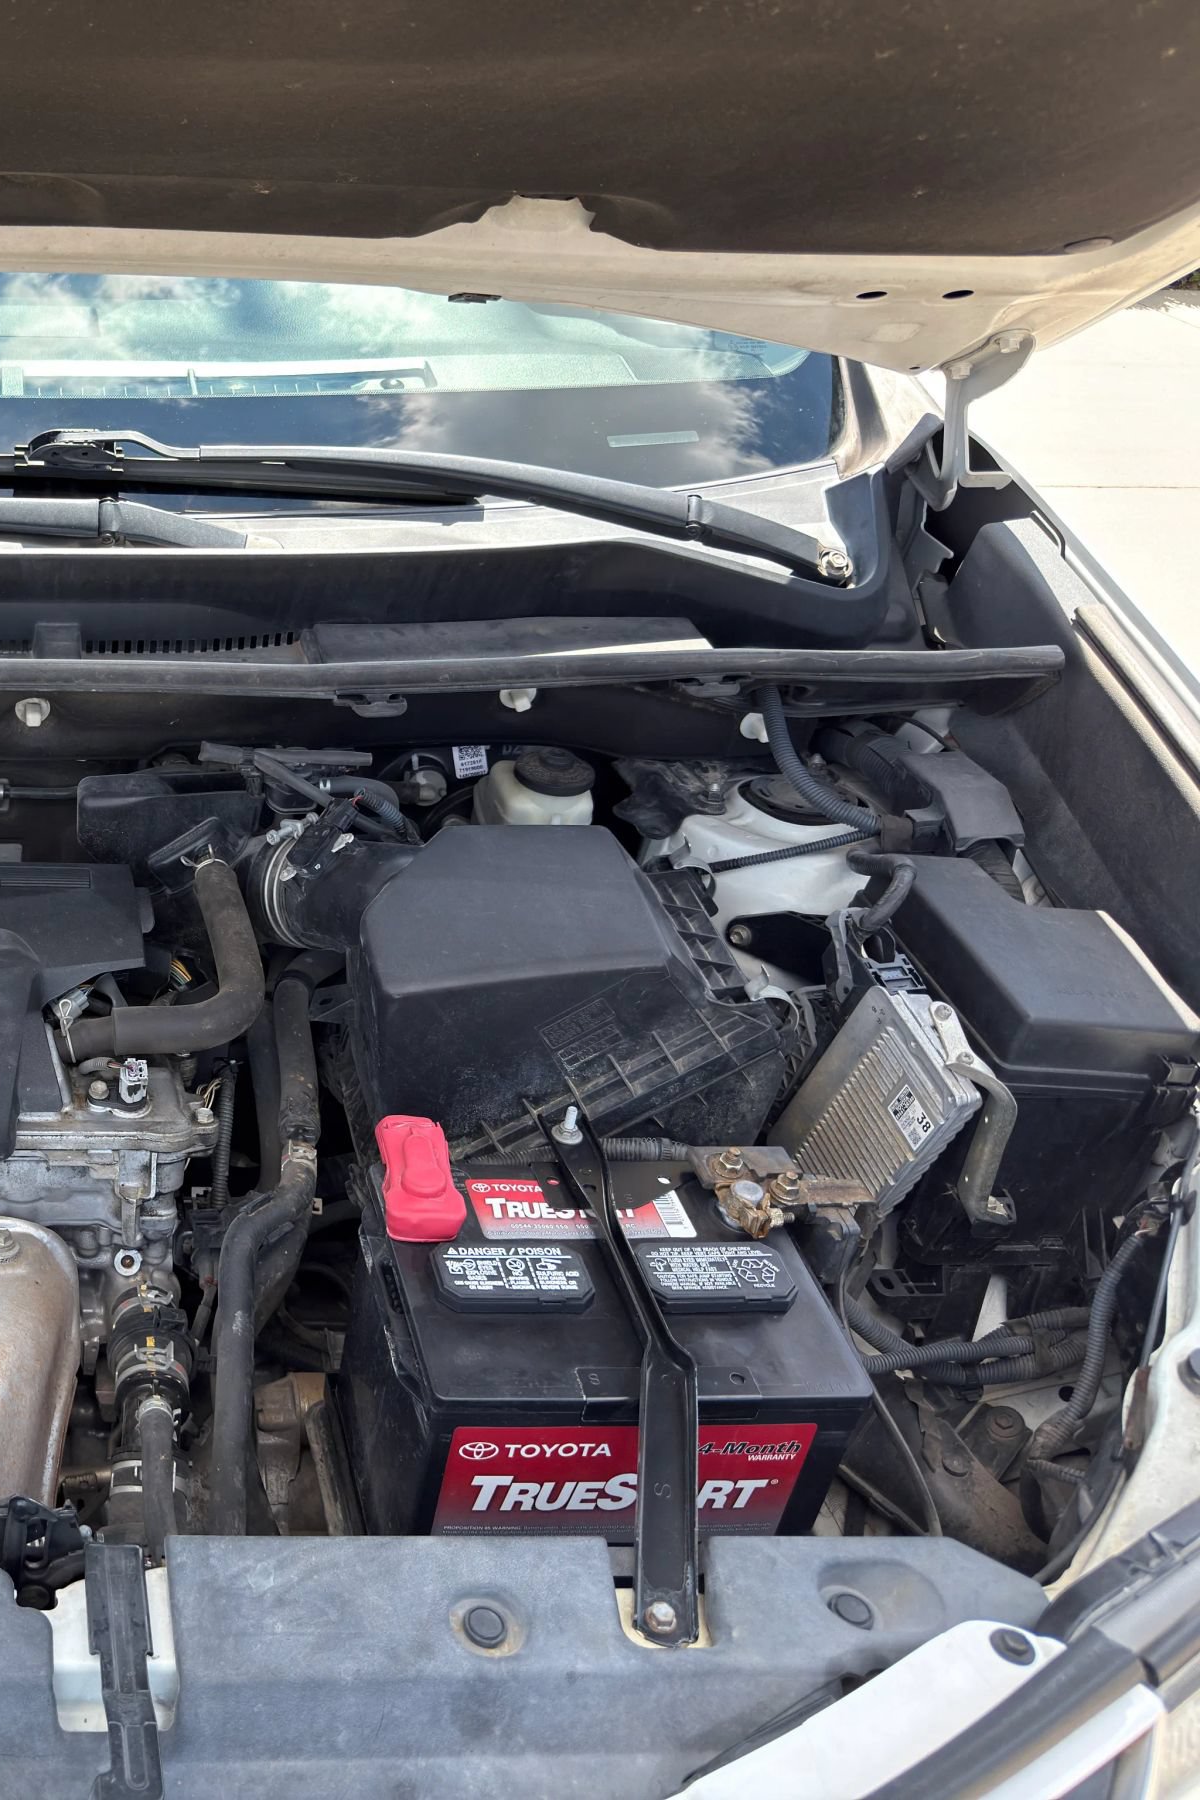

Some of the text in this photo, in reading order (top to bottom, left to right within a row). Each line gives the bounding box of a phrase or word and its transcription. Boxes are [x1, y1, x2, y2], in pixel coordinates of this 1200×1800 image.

[917, 1112, 931, 1133] 38
[494, 1183, 543, 1193] TOYOTA
[458, 1248, 507, 1256] DANGER
[518, 1248, 562, 1256] POISON
[505, 1443, 612, 1458] TOYOTA
[697, 1441, 802, 1456] 4-Month
[748, 1454, 796, 1462] WARRANTY
